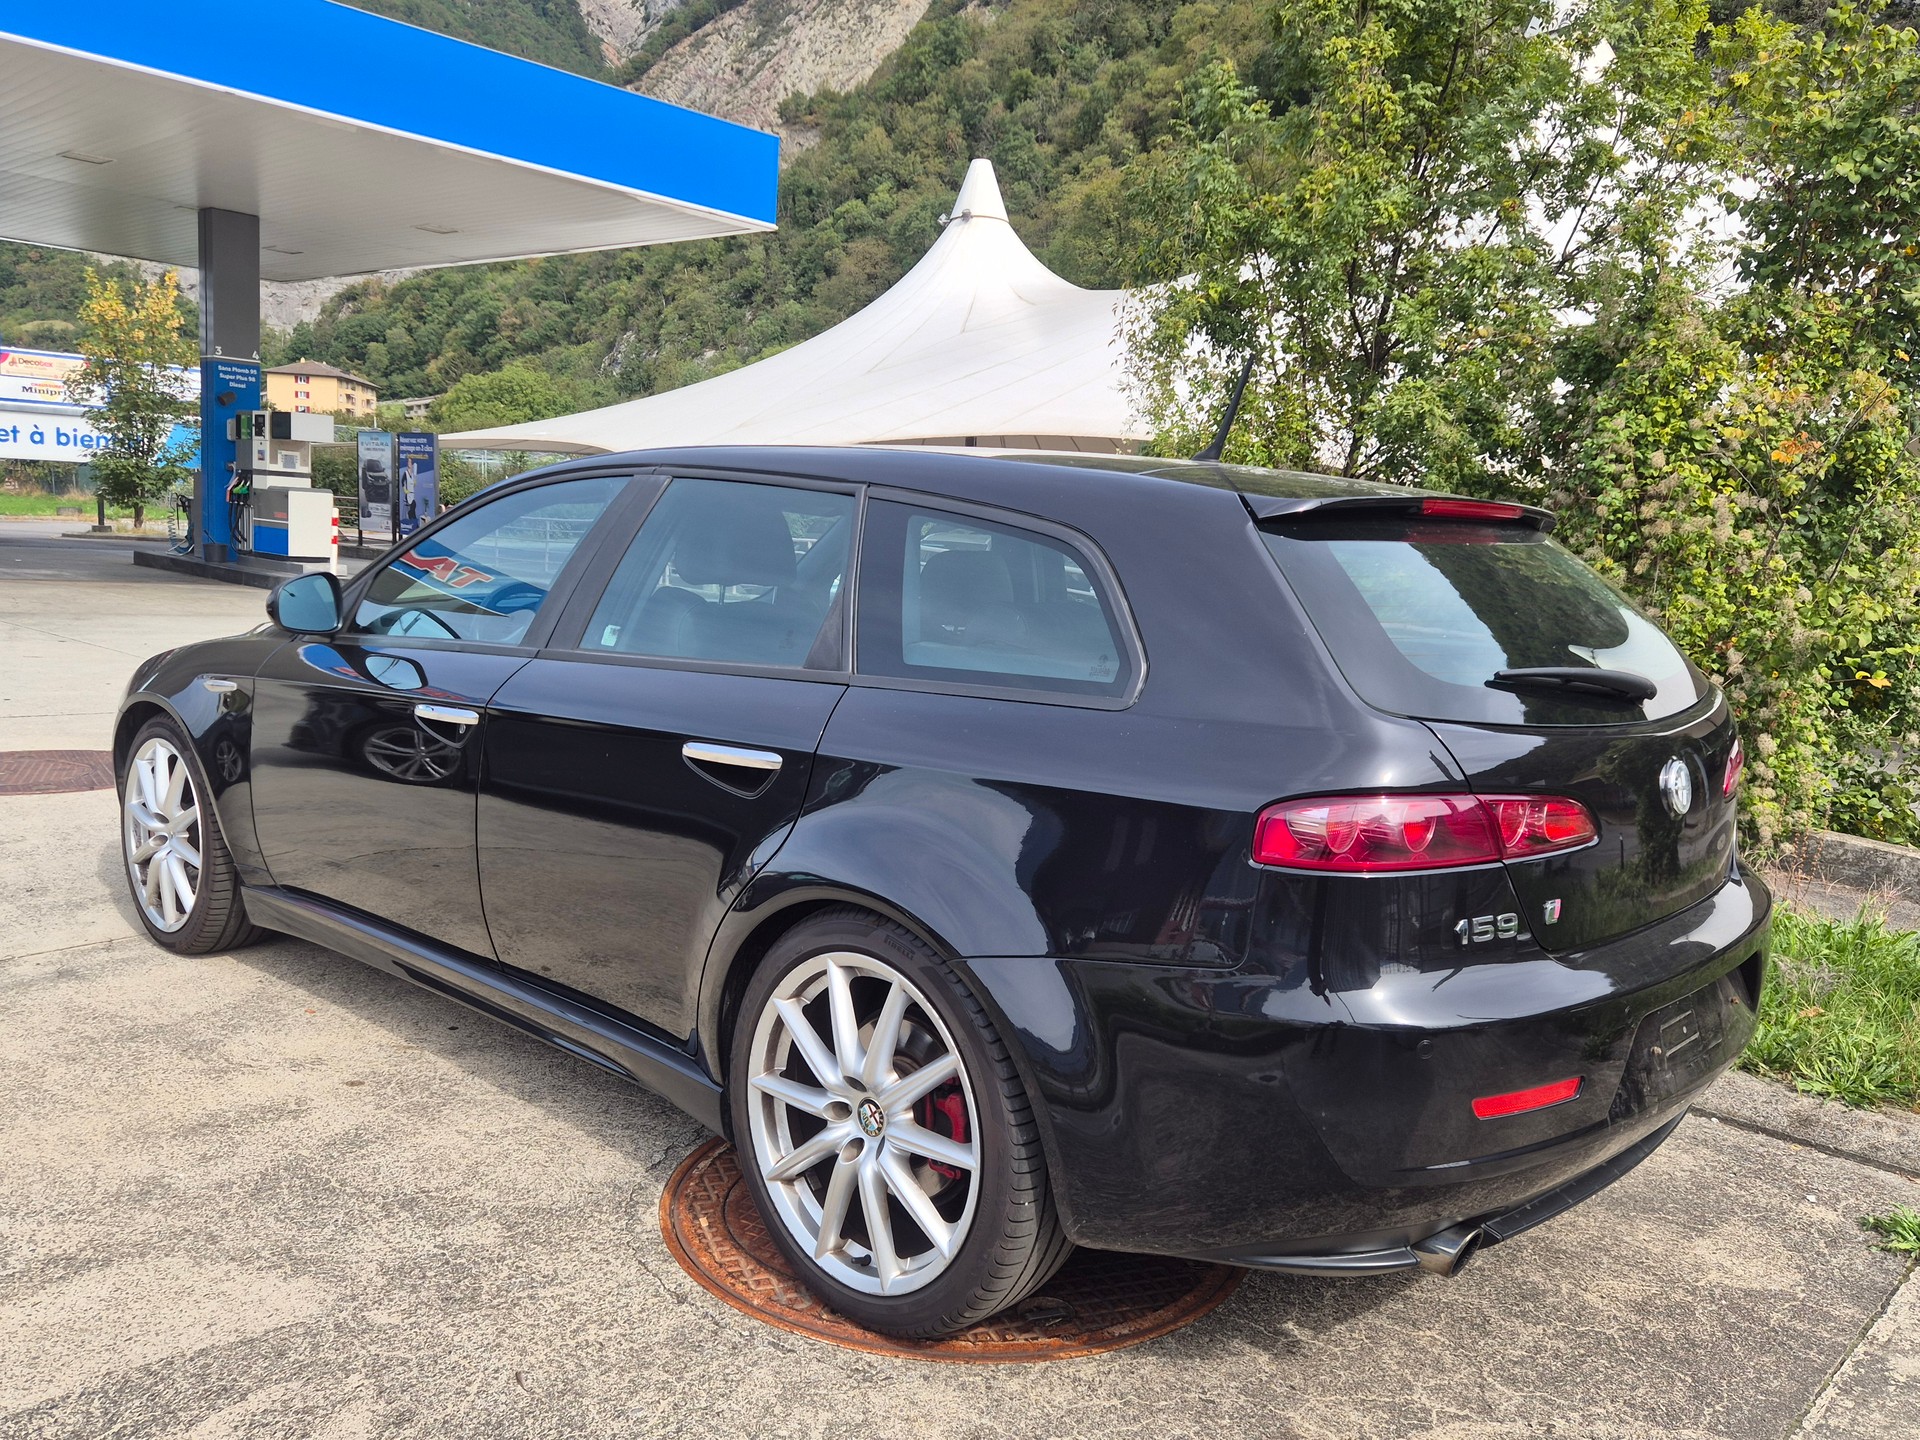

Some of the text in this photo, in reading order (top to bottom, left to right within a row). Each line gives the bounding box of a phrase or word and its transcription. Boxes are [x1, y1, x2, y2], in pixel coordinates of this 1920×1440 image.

[215, 346, 222, 355] 3
[252, 351, 259, 359] 4
[0, 425, 20, 443] et
[30, 424, 44, 445] à
[1454, 912, 1518, 945] 159
[885, 935, 915, 960] PIRELLI
